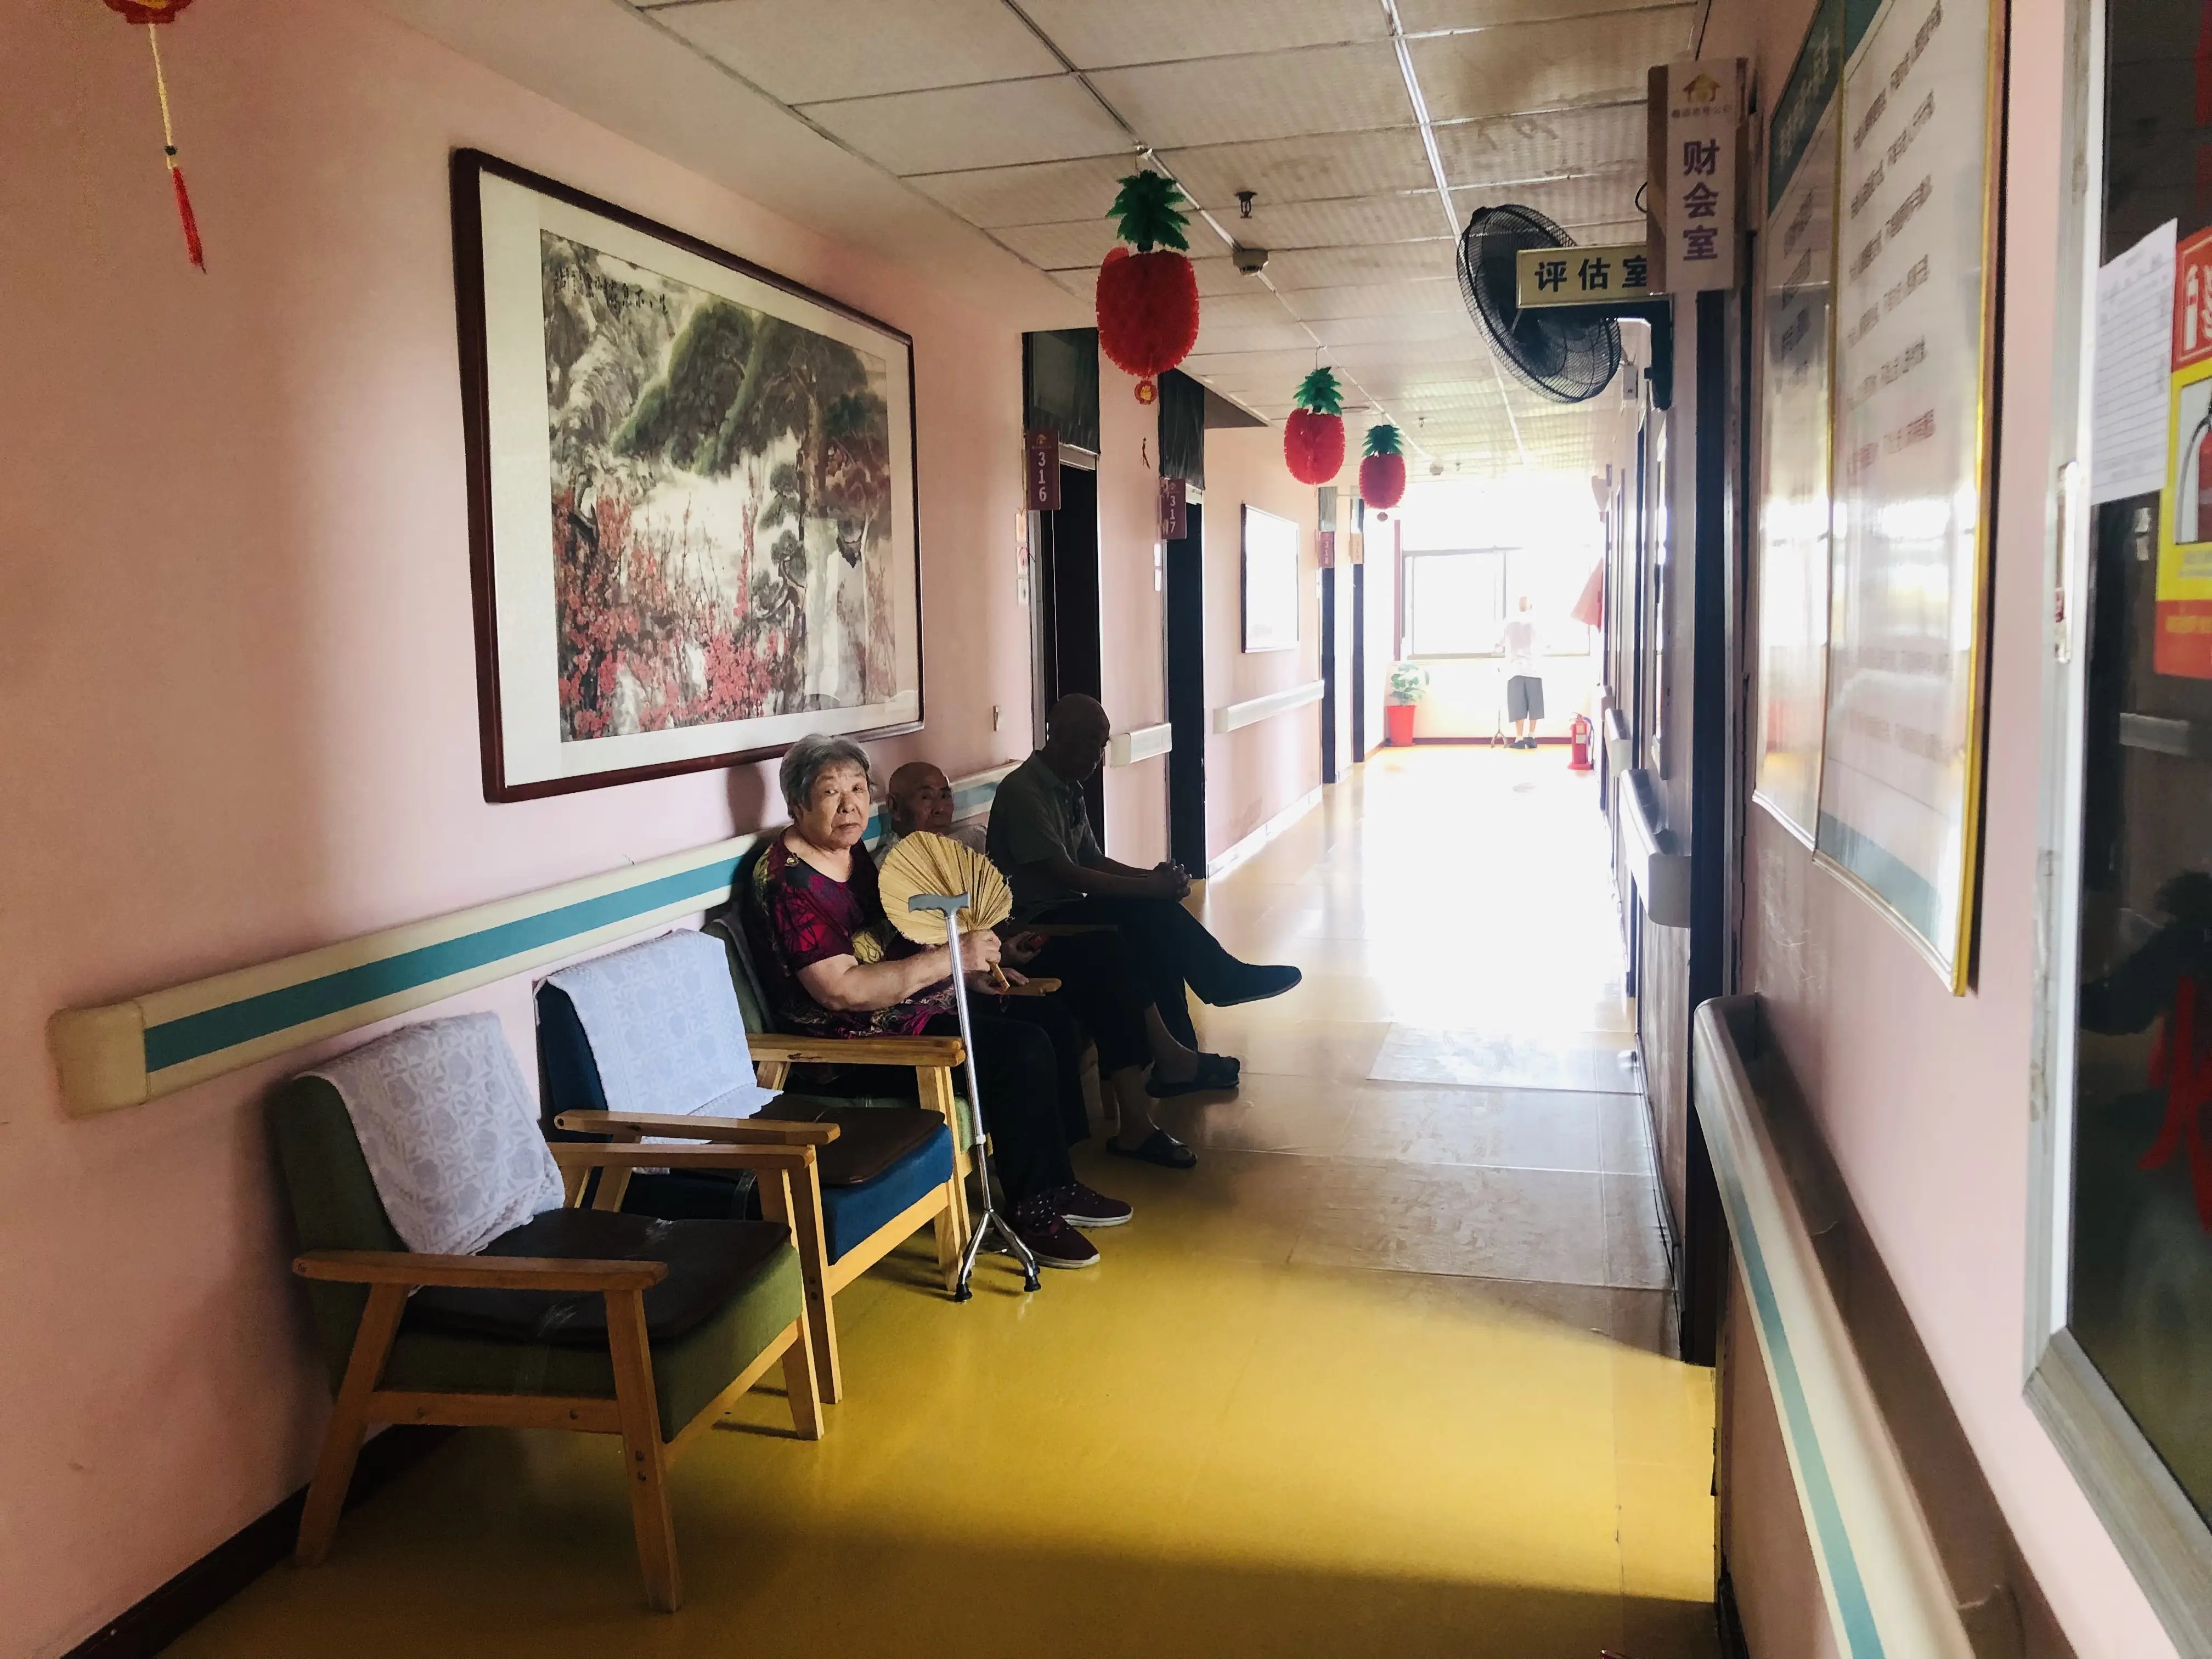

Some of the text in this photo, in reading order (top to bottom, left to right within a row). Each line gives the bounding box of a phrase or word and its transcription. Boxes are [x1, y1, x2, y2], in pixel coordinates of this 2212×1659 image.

[1682, 139, 1720, 262] 财会室
[1534, 254, 1647, 292] 评估室
[1037, 451, 1047, 503] 316
